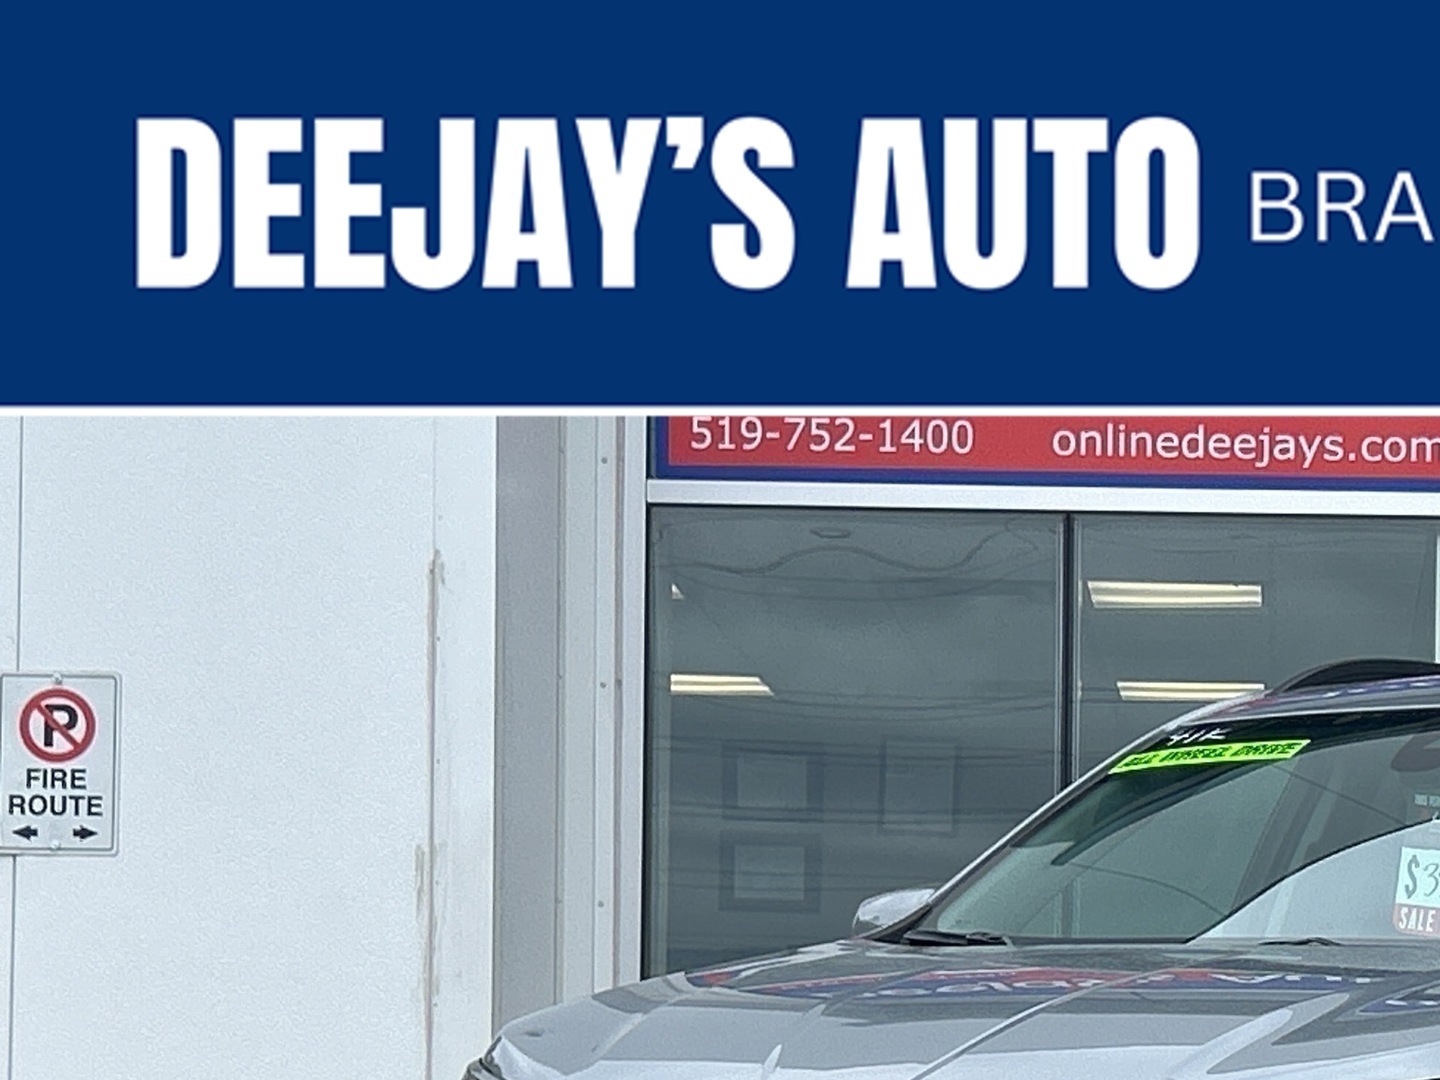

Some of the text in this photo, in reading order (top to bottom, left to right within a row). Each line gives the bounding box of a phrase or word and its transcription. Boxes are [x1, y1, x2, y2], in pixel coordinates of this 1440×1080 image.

[690, 416, 974, 454] 519-752-1400
[26, 768, 87, 790] FIRE
[8, 794, 103, 817] ROUTE
[1398, 906, 1436, 932] SALE
